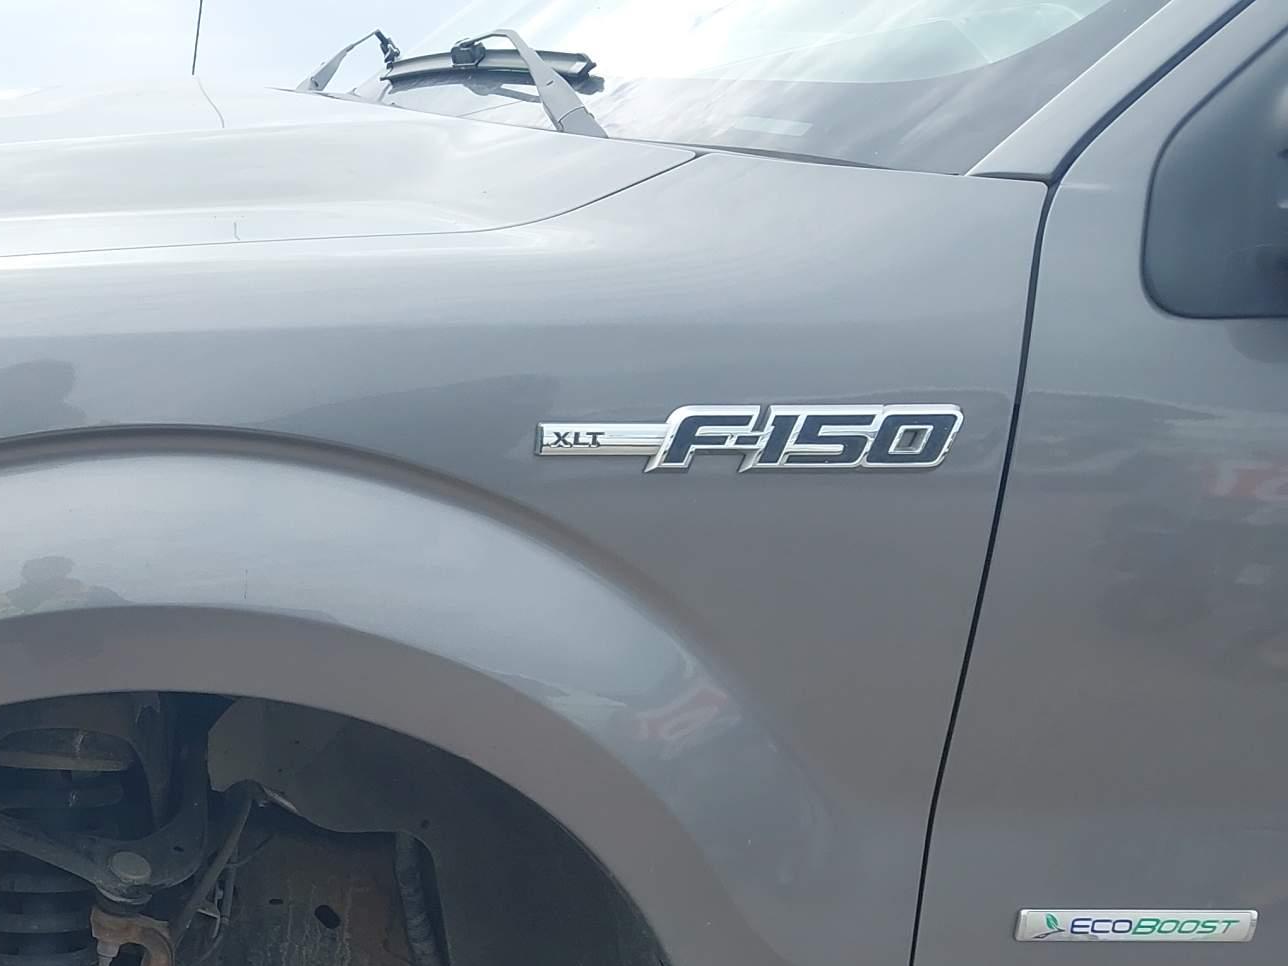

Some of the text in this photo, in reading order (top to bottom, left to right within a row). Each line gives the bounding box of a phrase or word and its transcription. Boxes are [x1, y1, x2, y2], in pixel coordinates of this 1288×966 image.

[550, 405, 963, 471] XLT F-150
[1070, 917, 1241, 935] ECOBOOST
